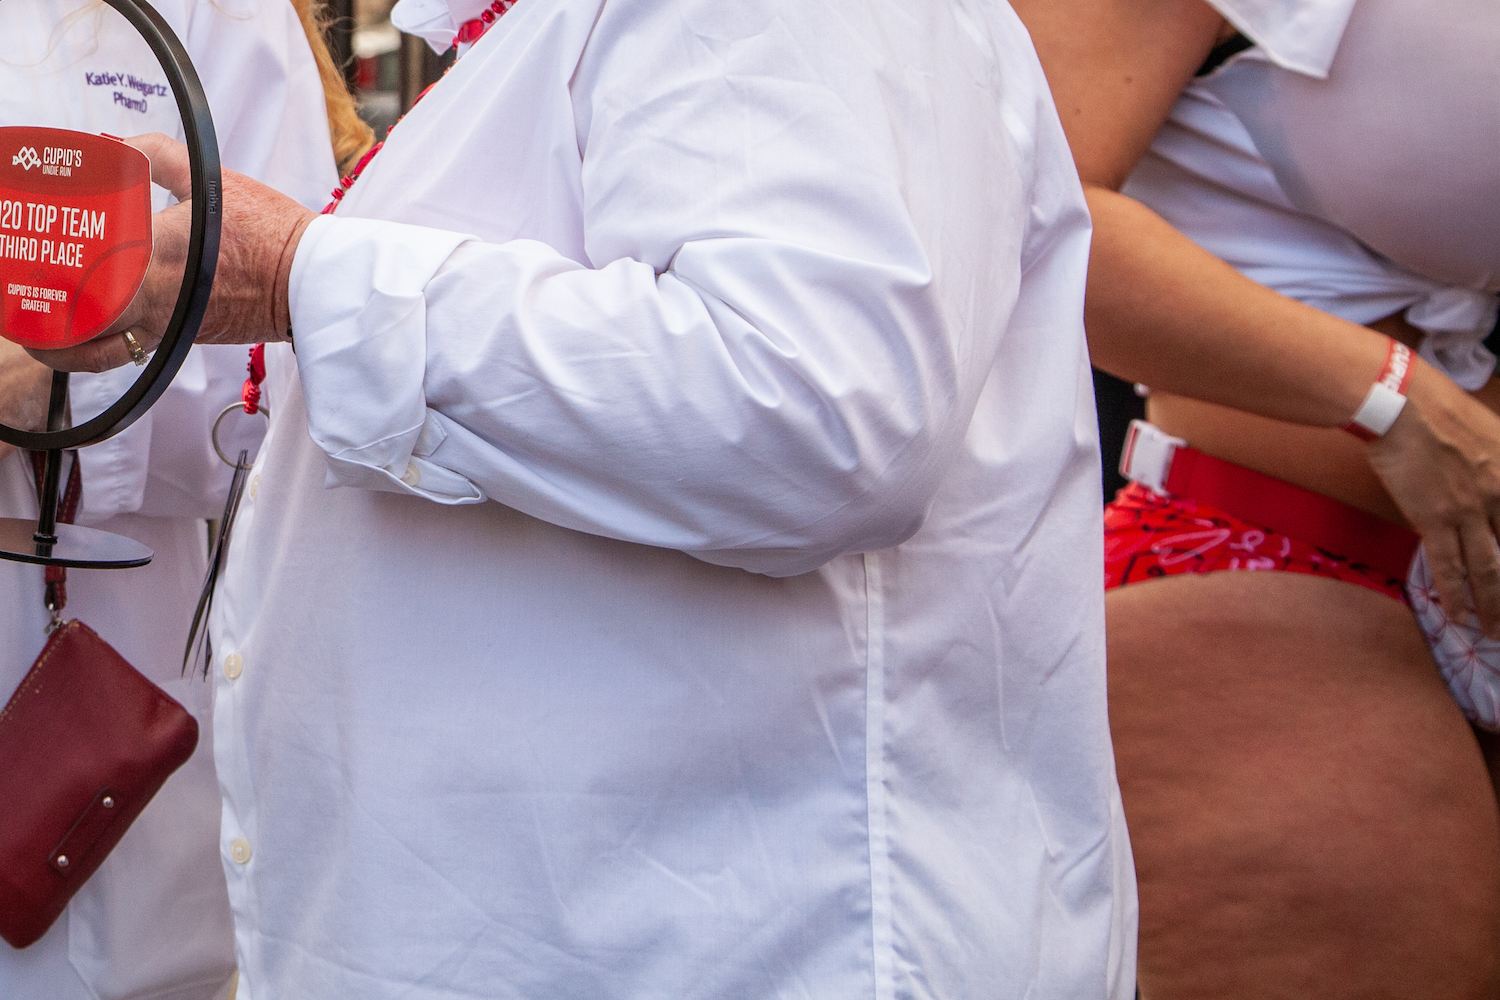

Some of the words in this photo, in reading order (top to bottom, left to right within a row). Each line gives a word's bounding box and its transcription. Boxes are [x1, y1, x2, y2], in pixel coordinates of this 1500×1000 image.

[113, 92, 148, 114] PharmD
[43, 147, 83, 167] CUPID'S
[42, 165, 59, 176] UNDIE
[59, 166, 72, 177] RUN
[27, 203, 57, 233] TOP
[61, 207, 106, 240] TEAM
[0, 234, 38, 261] THIRD
[41, 239, 84, 268] PLACE
[8, 283, 32, 297] CUPID'S
[32, 287, 39, 298] IS
[39, 288, 67, 302] FOREVER
[21, 298, 51, 314] GRATEFUL
